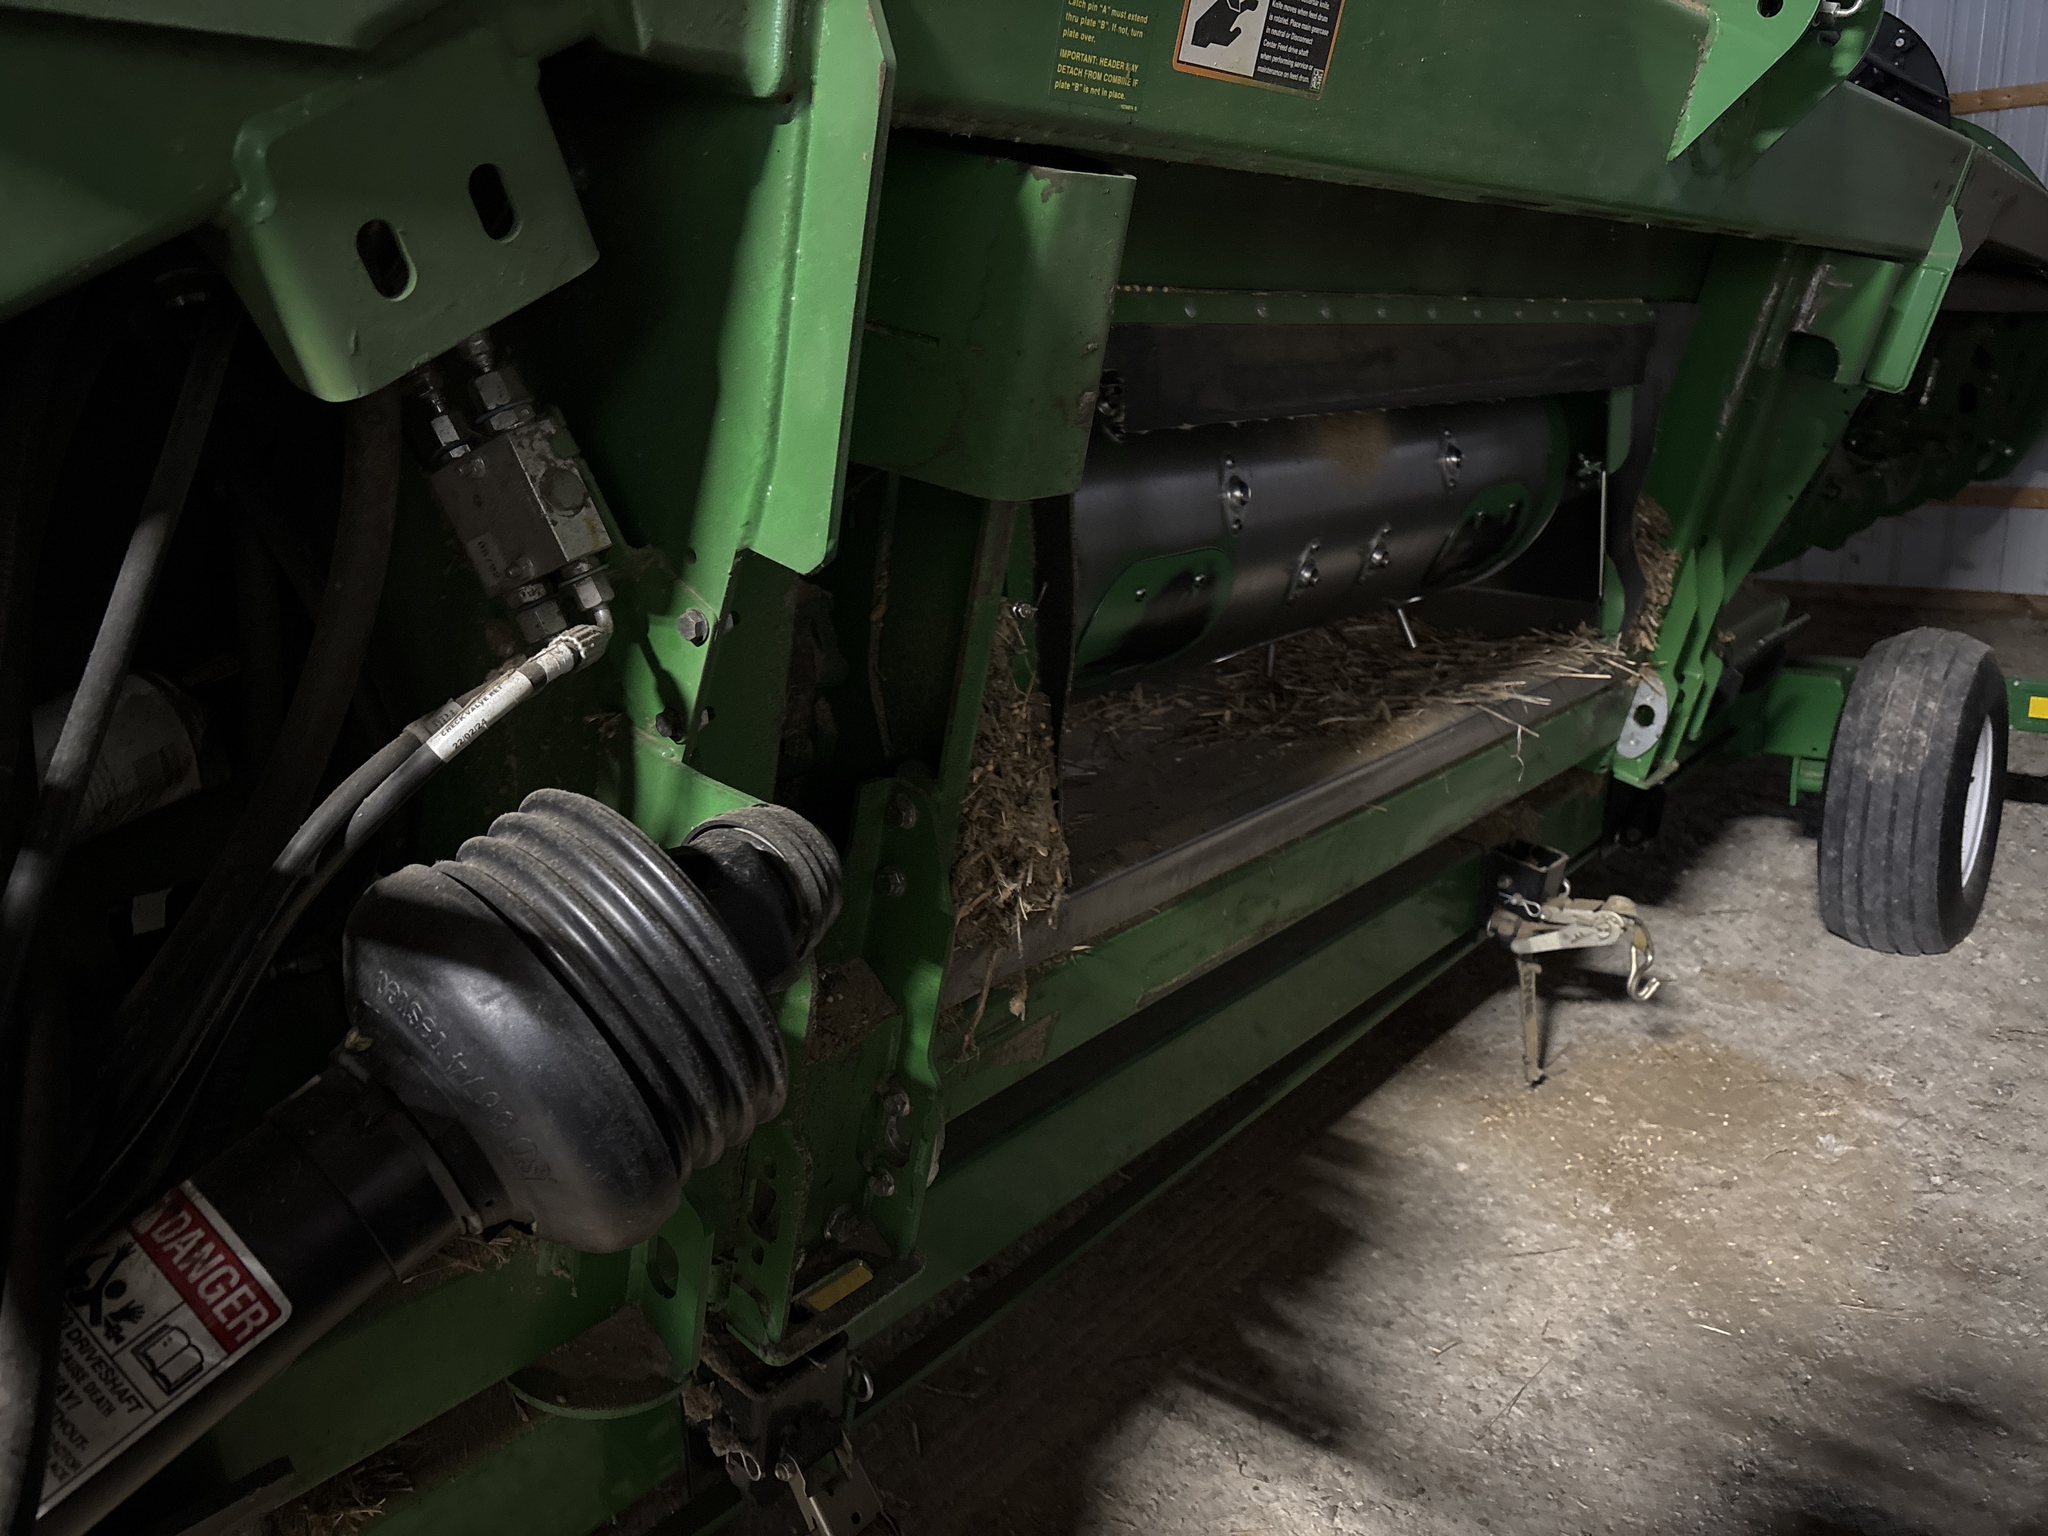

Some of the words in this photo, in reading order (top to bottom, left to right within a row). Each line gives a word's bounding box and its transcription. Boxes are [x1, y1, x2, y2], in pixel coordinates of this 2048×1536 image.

[1066, 12, 1079, 23] thru
[1080, 16, 1097, 28] plate
[1112, 23, 1116, 32] If
[1118, 25, 1129, 37] not,
[1131, 28, 1144, 38] turn
[1087, 3, 1098, 12] pin
[1100, 5, 1111, 14] "A"
[1111, 8, 1126, 19] must
[1128, 13, 1149, 24] extend
[1269, 13, 1273, 21] is
[1274, 15, 1290, 26] rotated.
[1290, 19, 1301, 28] Place
[1301, 23, 1311, 31] main
[1311, 26, 1330, 36] gearcase
[1283, 5, 1298, 14] moves
[1298, 8, 1309, 17] when
[1309, 11, 1318, 20] feed
[1318, 14, 1329, 23] drum
[1062, 28, 1079, 39] plate
[1080, 33, 1096, 43] over.
[1266, 26, 1271, 34] in
[1271, 29, 1286, 38] neutral
[1291, 32, 1313, 44] Disconnect
[1060, 48, 1098, 65] IMPORTANT:
[1099, 57, 1125, 71] HEADER
[1263, 39, 1278, 49] Center
[1277, 42, 1288, 52] Feed
[1288, 45, 1299, 55] drive
[1299, 48, 1309, 57] shaft
[1260, 52, 1272, 61] when
[1271, 56, 1294, 69] performing
[1294, 61, 1309, 70] service
[1057, 64, 1083, 77] DETACH
[1084, 70, 1103, 81] FROM
[1103, 74, 1132, 87] COMBINE
[1132, 79, 1139, 87] IF
[1257, 65, 1284, 77] maintenance
[1283, 71, 1290, 79] on
[1290, 72, 1299, 81] feed
[1299, 74, 1310, 83] drum.
[1054, 80, 1070, 90] plate
[1072, 82, 1083, 92] "B"
[1083, 84, 1089, 94] is
[1090, 86, 1100, 96] not
[1101, 87, 1107, 96] in
[1108, 90, 1126, 100] place.
[441, 713, 466, 736] CHECK
[466, 694, 489, 715] VALVE
[452, 718, 487, 750] 22/02/24
[151, 1208, 270, 1343] DANGER
[66, 1327, 144, 1413] DRIVESHAFT
[83, 1382, 117, 1418] DEATH
